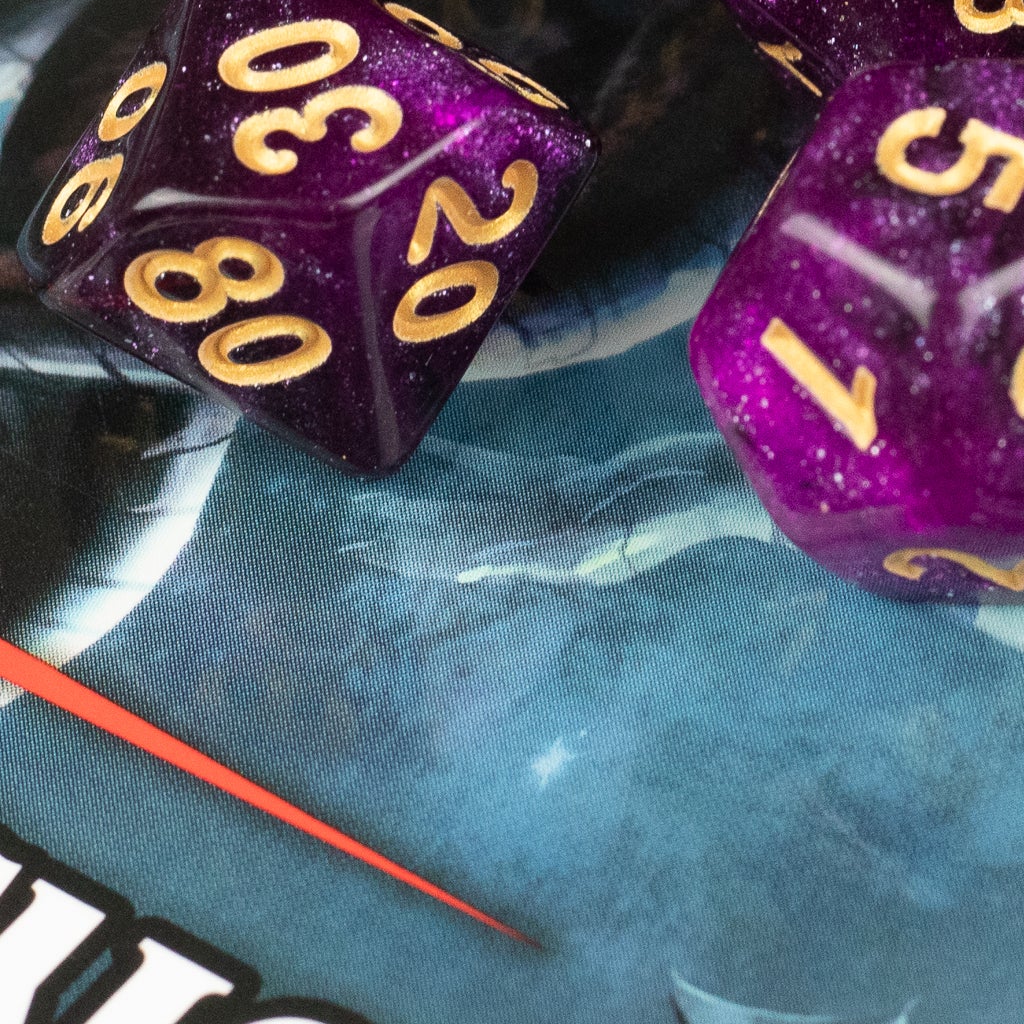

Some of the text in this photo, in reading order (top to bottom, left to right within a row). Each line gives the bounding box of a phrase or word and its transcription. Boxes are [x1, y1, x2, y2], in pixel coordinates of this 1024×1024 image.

[217, 18, 403, 175] 30
[123, 235, 332, 387] 80
[392, 159, 540, 343] 20
[760, 317, 877, 452] 1
